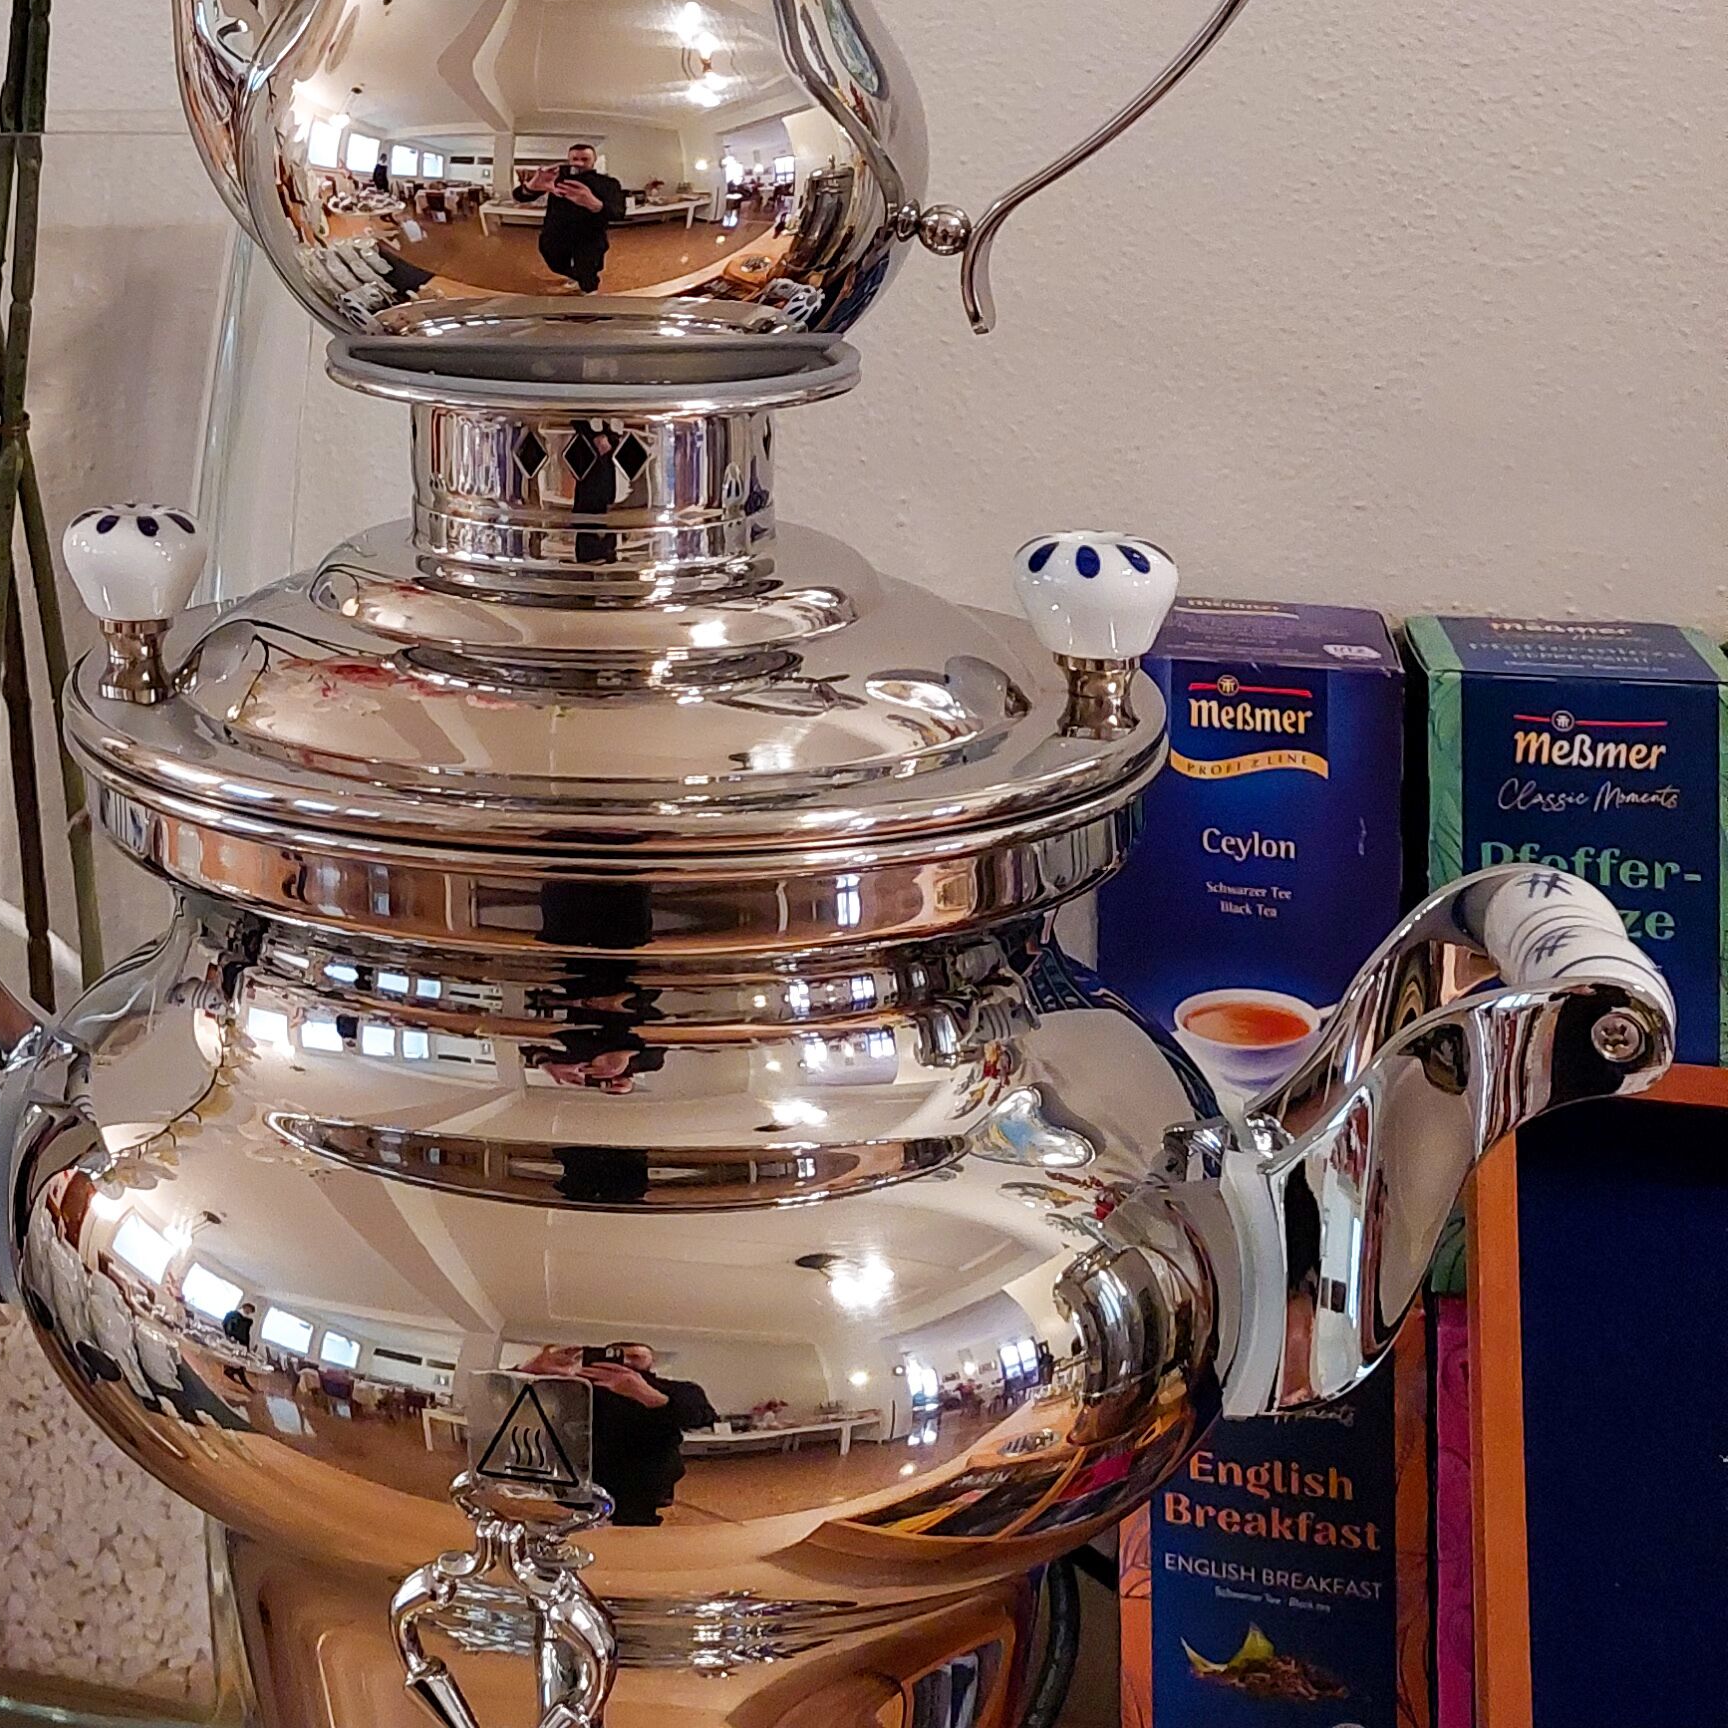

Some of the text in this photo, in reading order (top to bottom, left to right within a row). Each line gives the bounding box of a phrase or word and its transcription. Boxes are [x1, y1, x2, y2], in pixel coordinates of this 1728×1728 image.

[1188, 698, 1313, 734] Meßmer
[1187, 753, 1307, 775] PROFI LINE
[1513, 731, 1666, 770] Meßmer
[1498, 778, 1680, 812] Classic Moments
[1202, 827, 1296, 862] Ceylon
[1220, 900, 1252, 915] Black
[1189, 1450, 1354, 1501] English
[1164, 1491, 1381, 1551] Breakfast
[1164, 1552, 1256, 1583] ENGLISH
[1262, 1568, 1383, 1601] BREAKFAST
